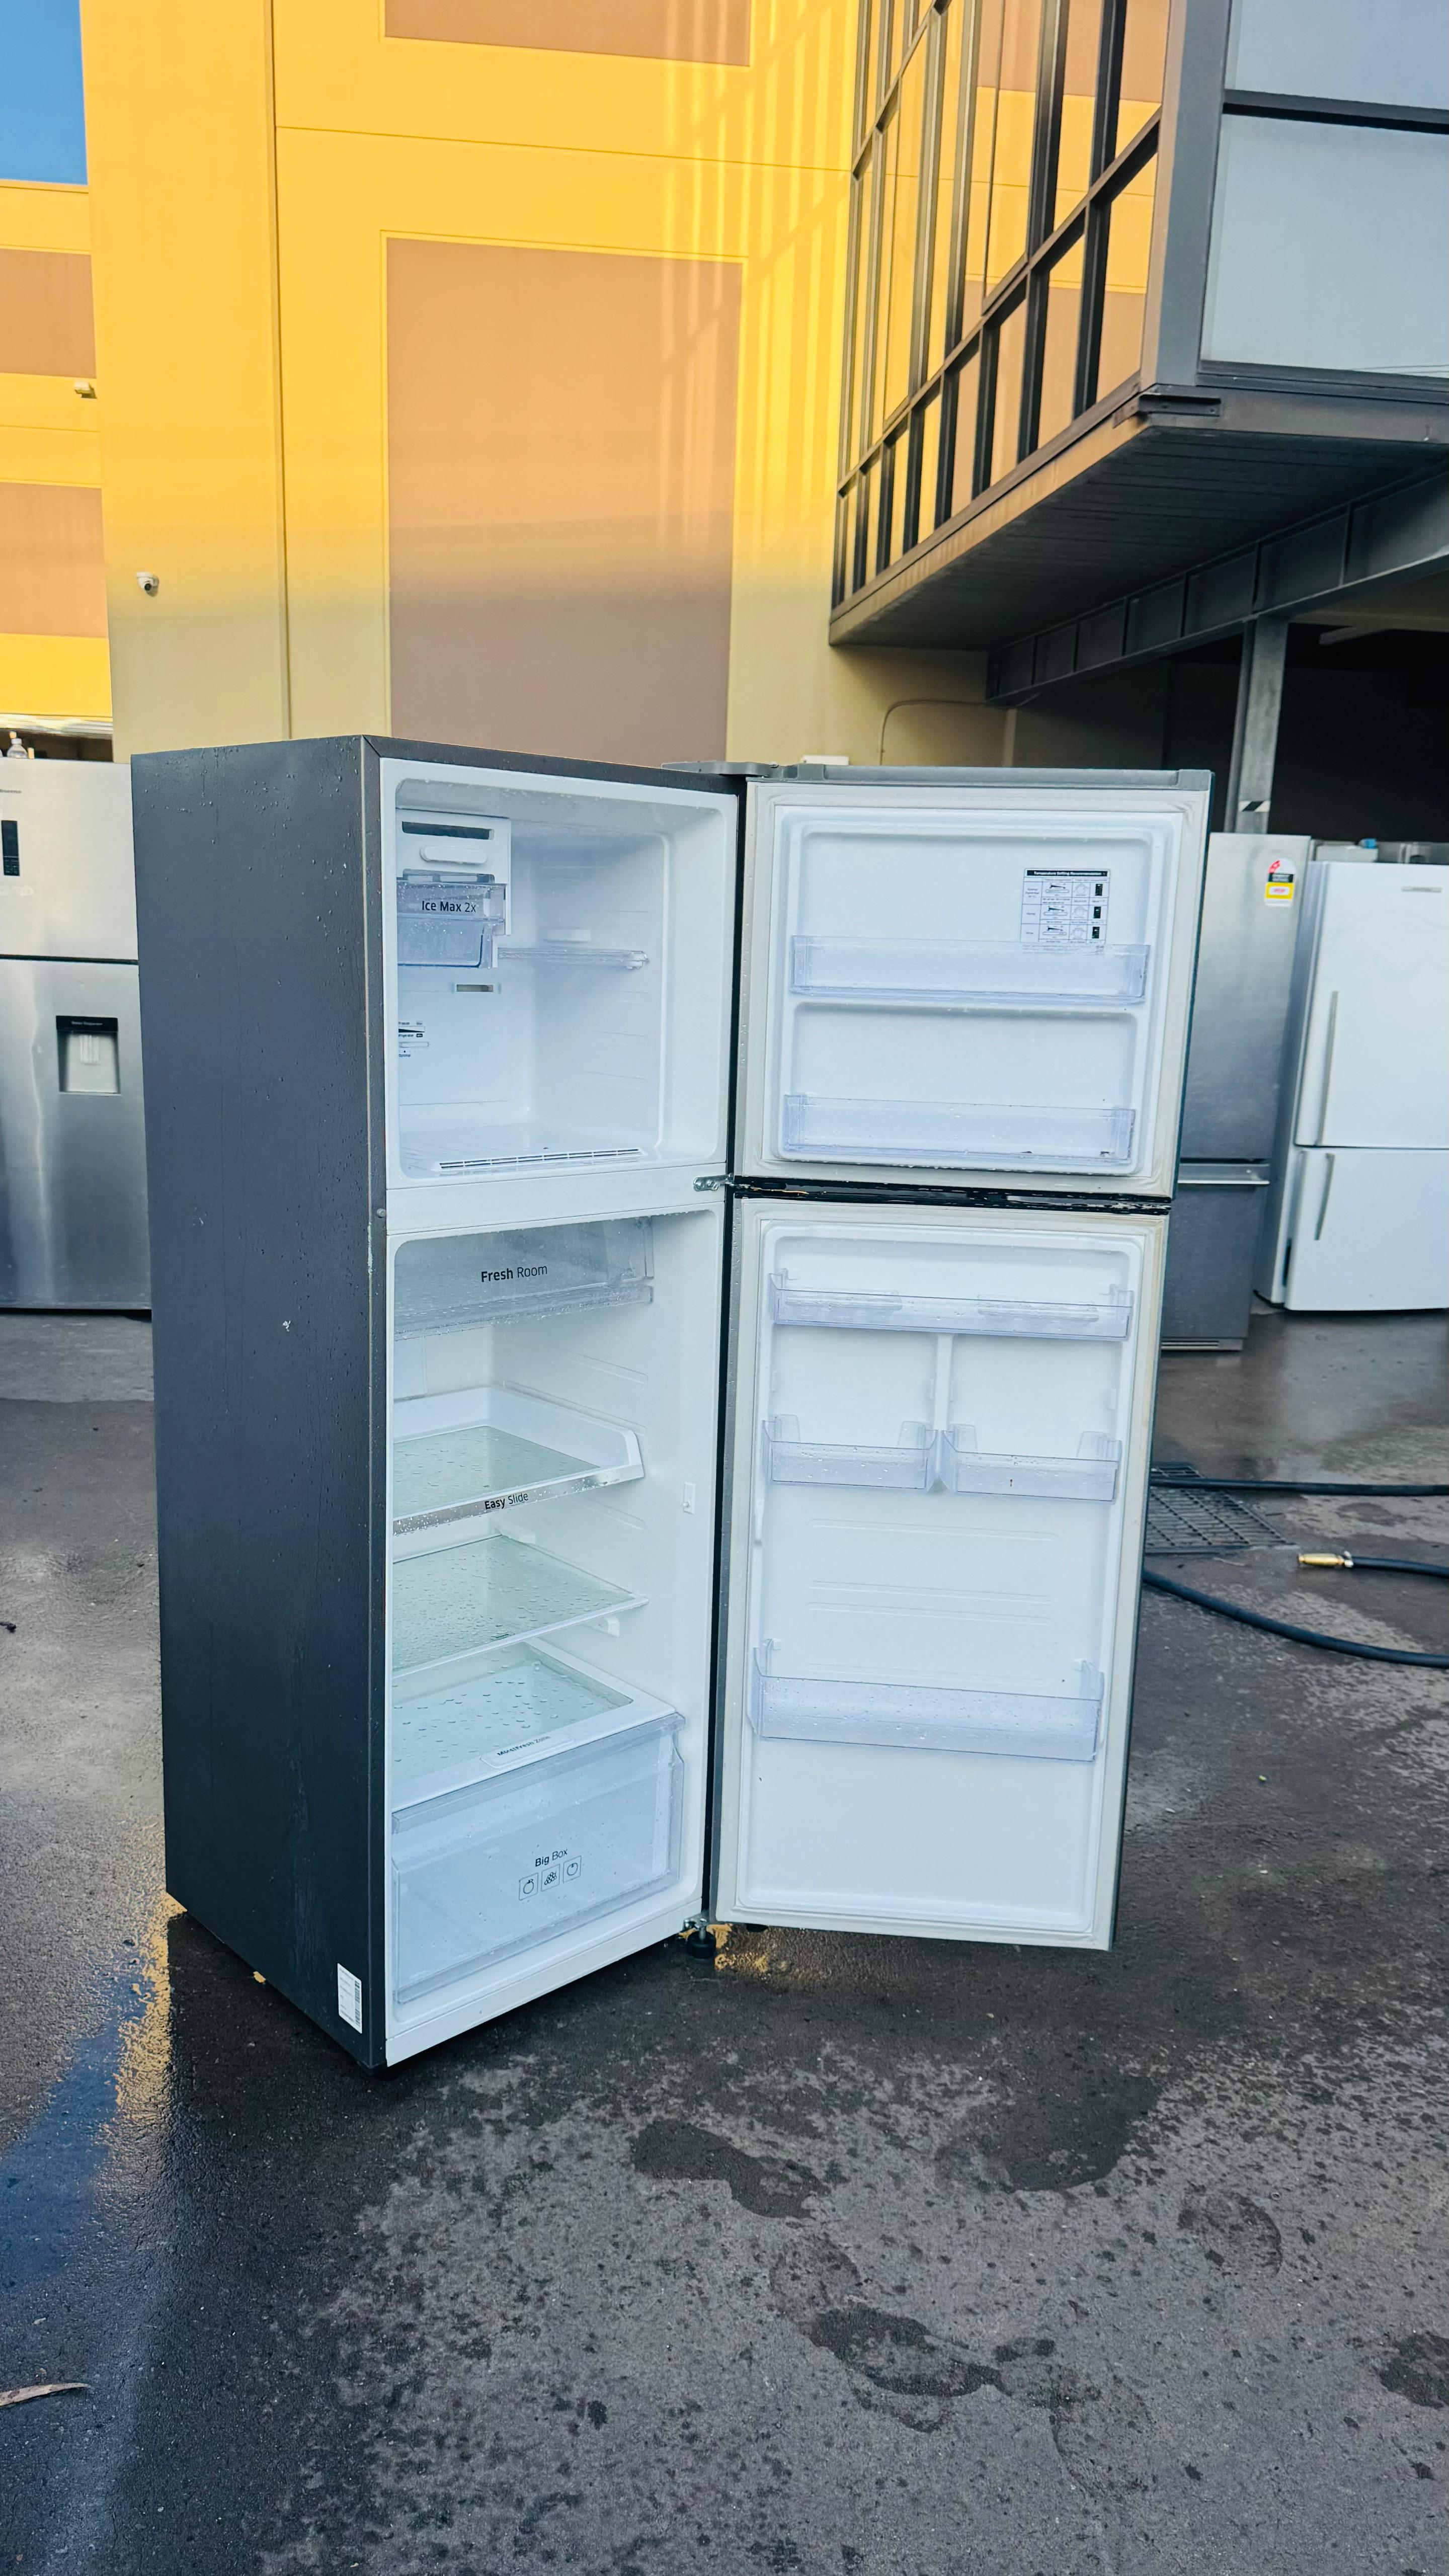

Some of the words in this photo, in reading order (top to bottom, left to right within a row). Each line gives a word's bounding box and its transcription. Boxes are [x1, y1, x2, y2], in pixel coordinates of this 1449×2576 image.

[422, 901, 436, 911] Ice
[440, 902, 461, 912] Max
[465, 903, 476, 912] 2x
[481, 1268, 513, 1282] Fresh
[517, 1266, 547, 1278] Room
[485, 1498, 505, 1510] Easy
[508, 1492, 529, 1504] Slide
[535, 1857, 549, 1867] Big
[552, 1849, 568, 1861] Box
